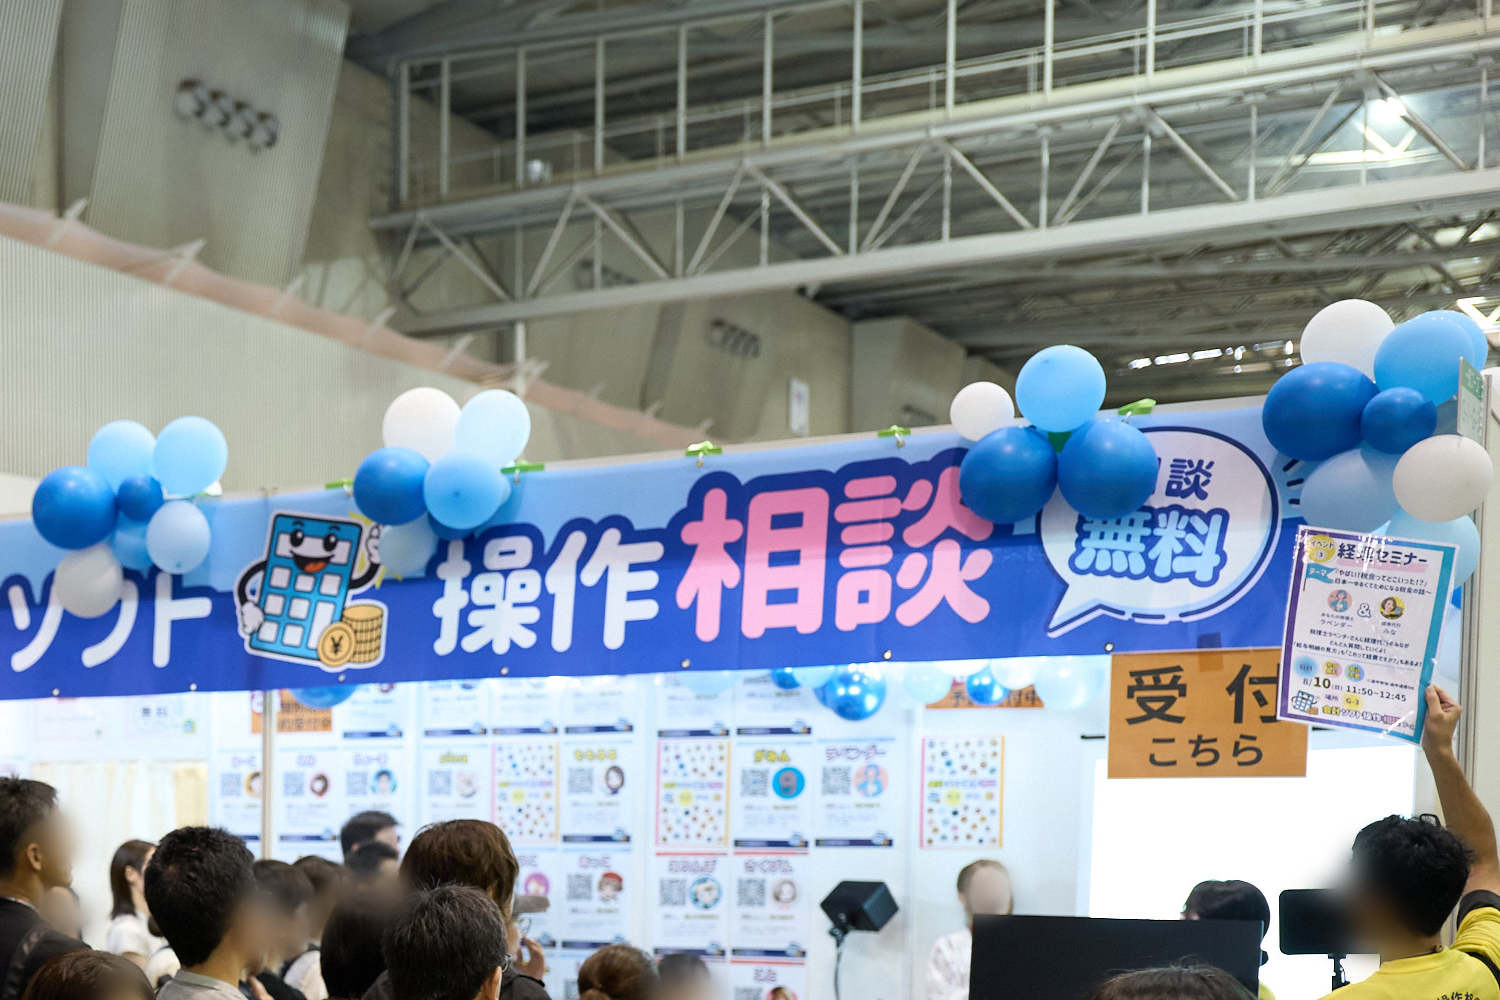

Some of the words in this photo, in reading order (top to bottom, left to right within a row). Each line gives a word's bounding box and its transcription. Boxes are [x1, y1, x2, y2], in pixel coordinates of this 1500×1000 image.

[1156, 457, 1214, 502] 談
[1073, 509, 1227, 582] 無料
[1311, 539, 1335, 549] イベント
[433, 466, 995, 657] 操作相談
[1308, 567, 1327, 577] テーマ
[1320, 619, 1353, 629] ラベンダー
[1382, 628, 1397, 636] みな
[1125, 664, 1281, 726] 受付
[1147, 734, 1264, 768] こちら
